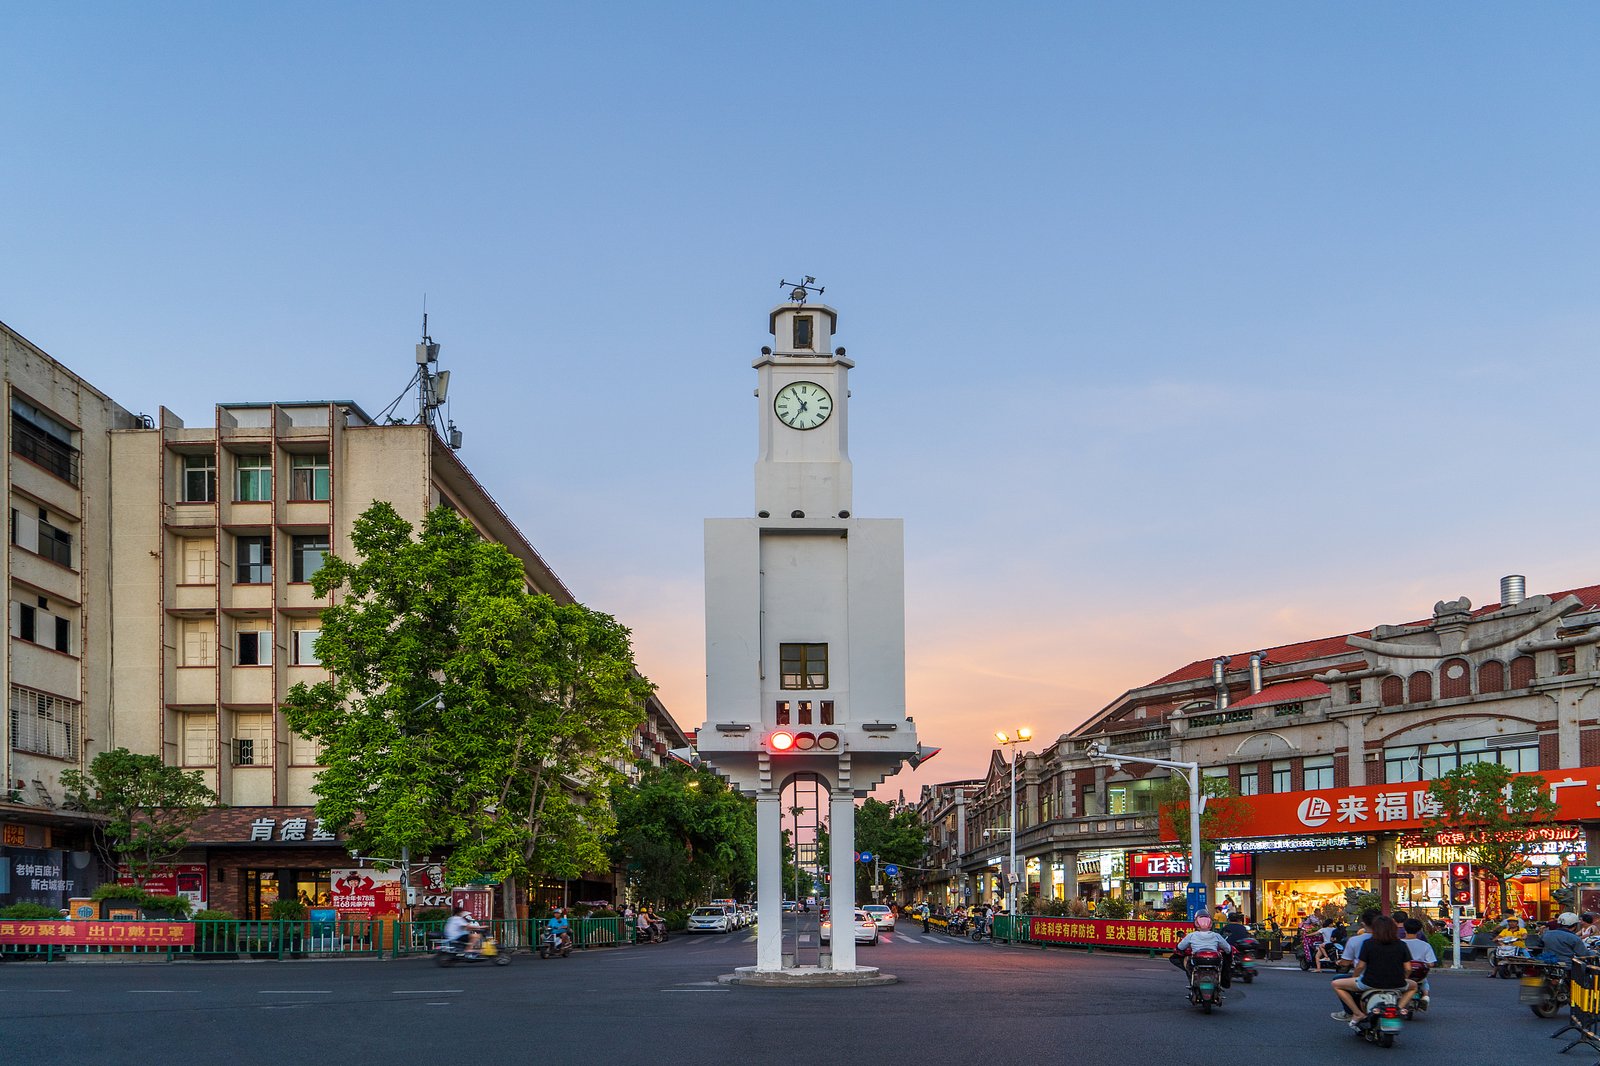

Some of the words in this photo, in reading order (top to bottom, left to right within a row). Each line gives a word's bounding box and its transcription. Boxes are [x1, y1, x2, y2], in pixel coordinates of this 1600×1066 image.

[251, 818, 336, 841] 肯德基
[31, 879, 74, 891] 新古城客厅
[89, 924, 185, 938] 出门戴口罩
